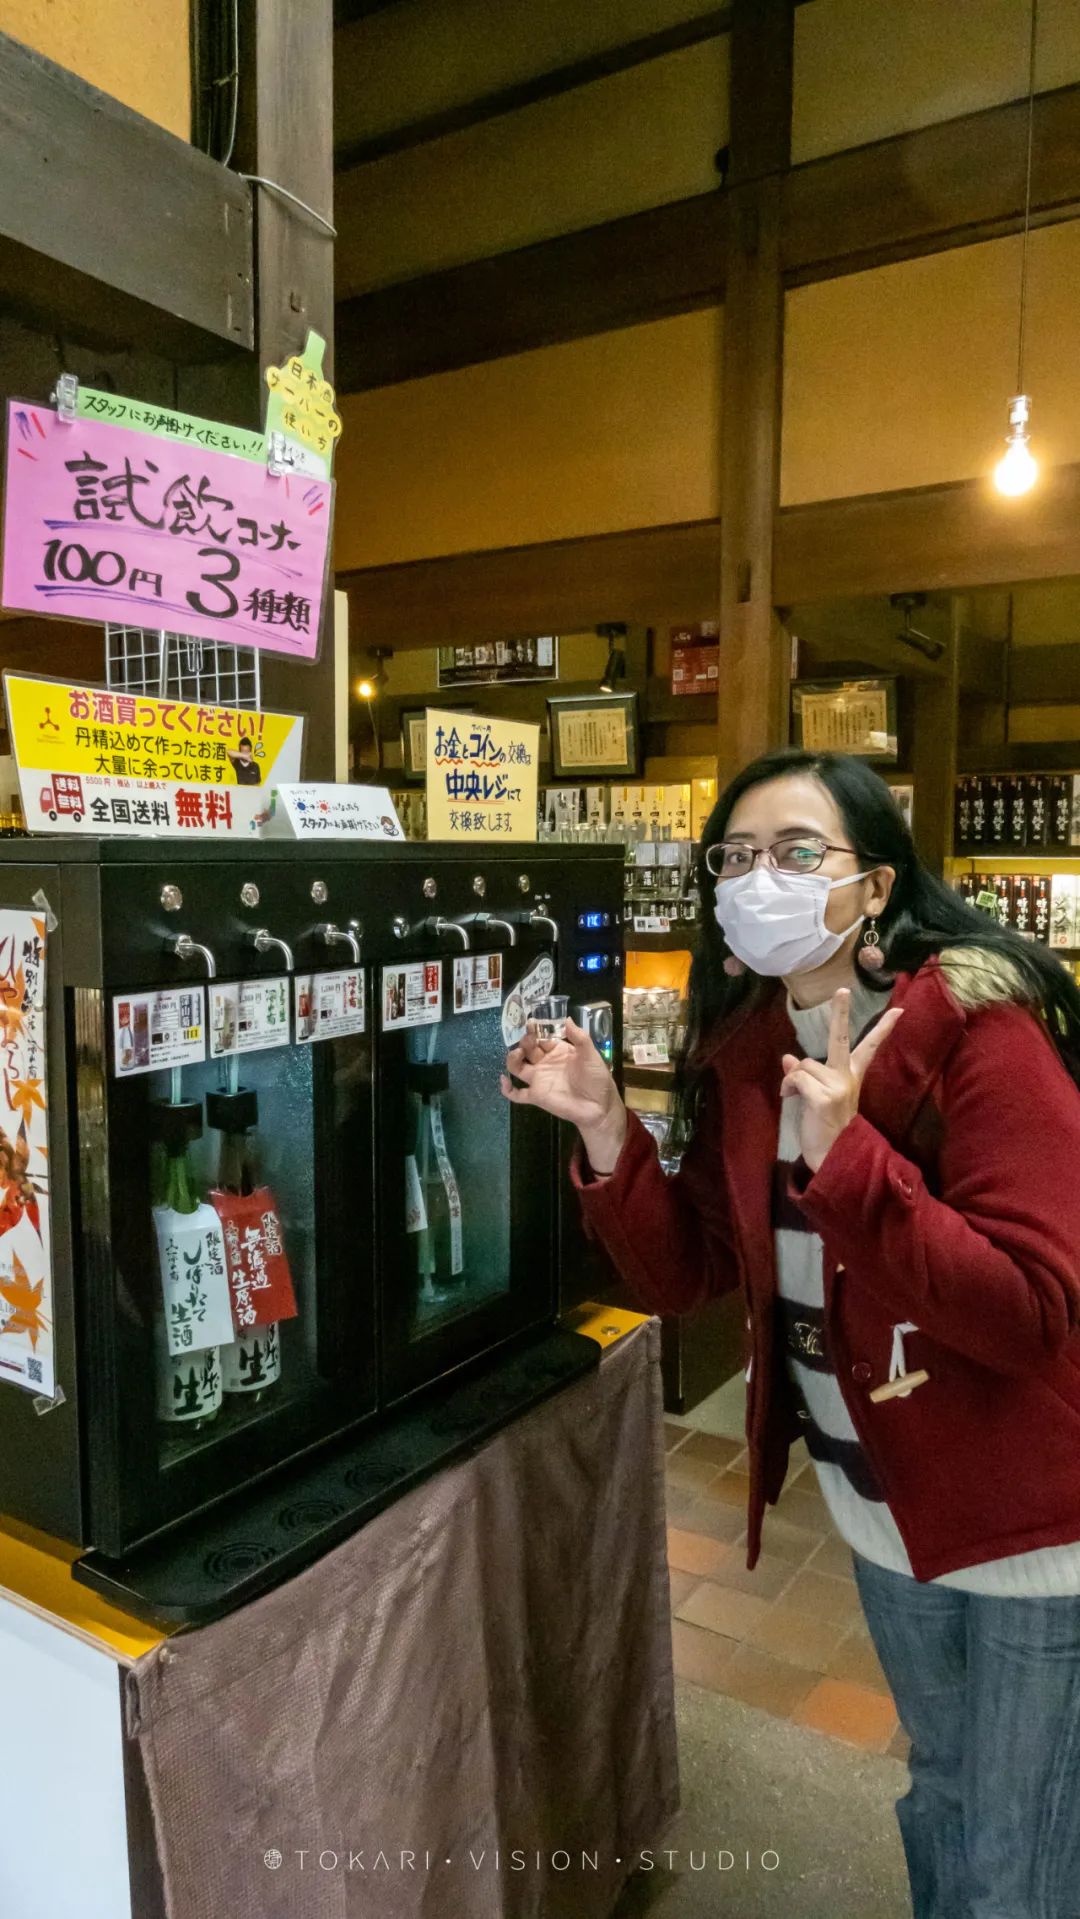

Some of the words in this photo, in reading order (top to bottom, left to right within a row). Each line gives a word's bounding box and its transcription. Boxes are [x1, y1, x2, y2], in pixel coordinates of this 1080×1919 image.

[65, 451, 303, 550] 試飲コーナー
[43, 539, 163, 597] 100円
[185, 548, 313, 634] 3種類
[75, 727, 227, 761] 丹精込めて作ったお酒
[95, 754, 226, 783] 大量に余っています
[446, 768, 522, 801] 中央レジにて
[90, 797, 170, 826] 全国送料
[175, 788, 233, 830] 無料
[170, 1302, 193, 1347] 生酒
